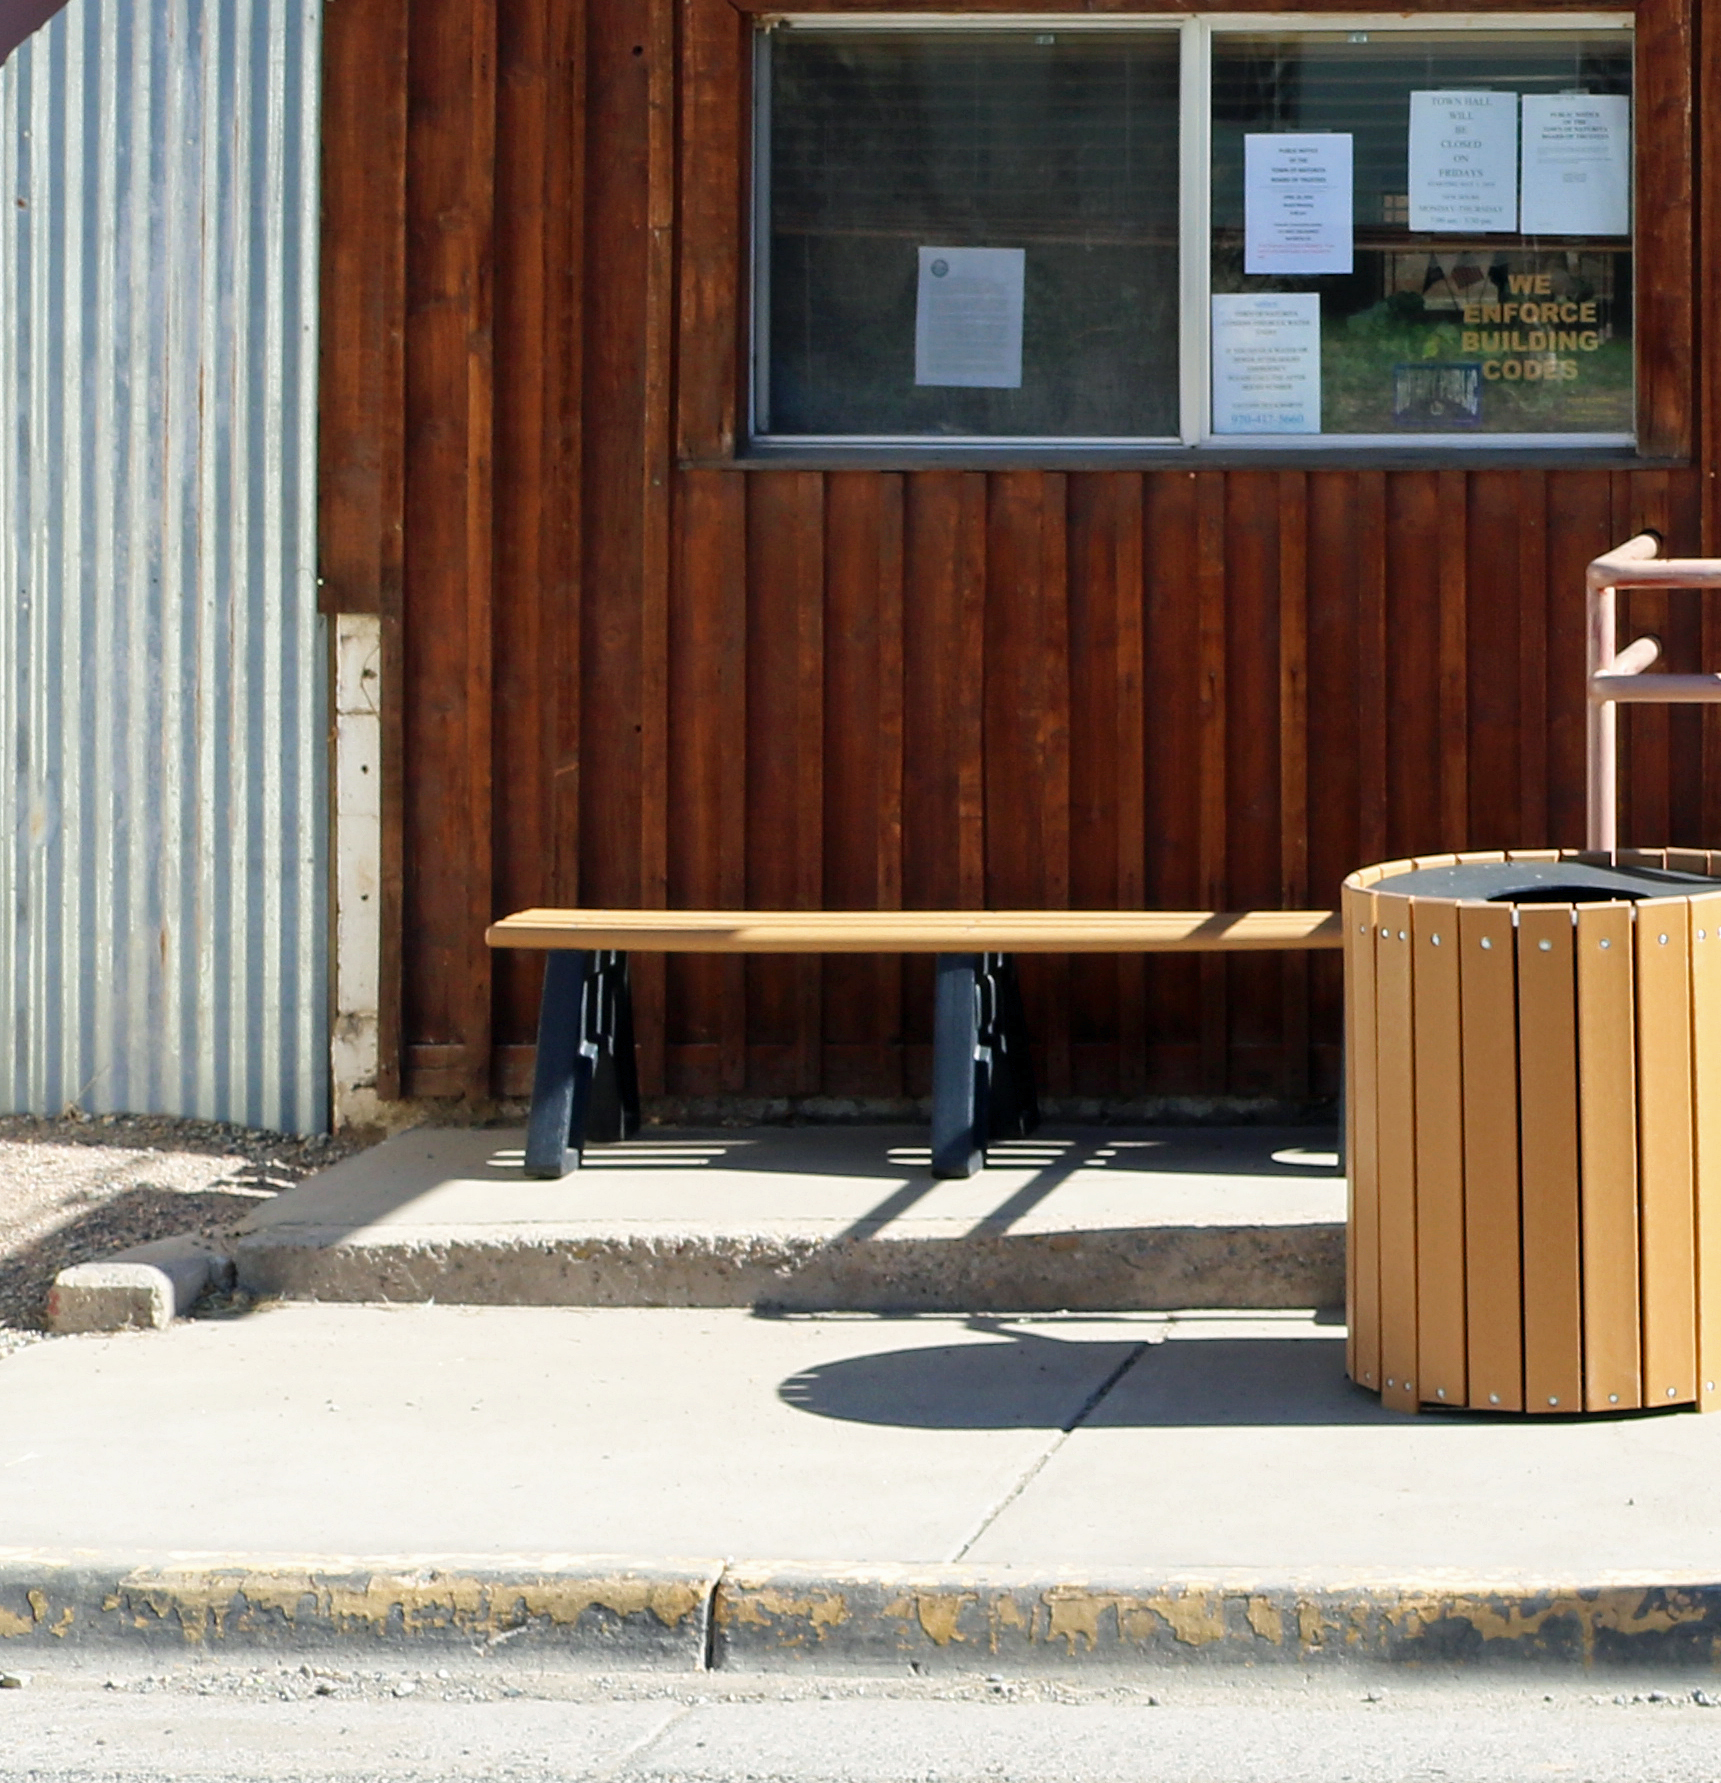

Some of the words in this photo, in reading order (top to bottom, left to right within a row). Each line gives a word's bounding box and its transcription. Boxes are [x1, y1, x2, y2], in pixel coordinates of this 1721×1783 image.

[1508, 274, 1553, 295] WE
[1463, 302, 1598, 324] ENFORCE
[1461, 331, 1599, 352] BUILDING
[1482, 359, 1578, 381] CODES
